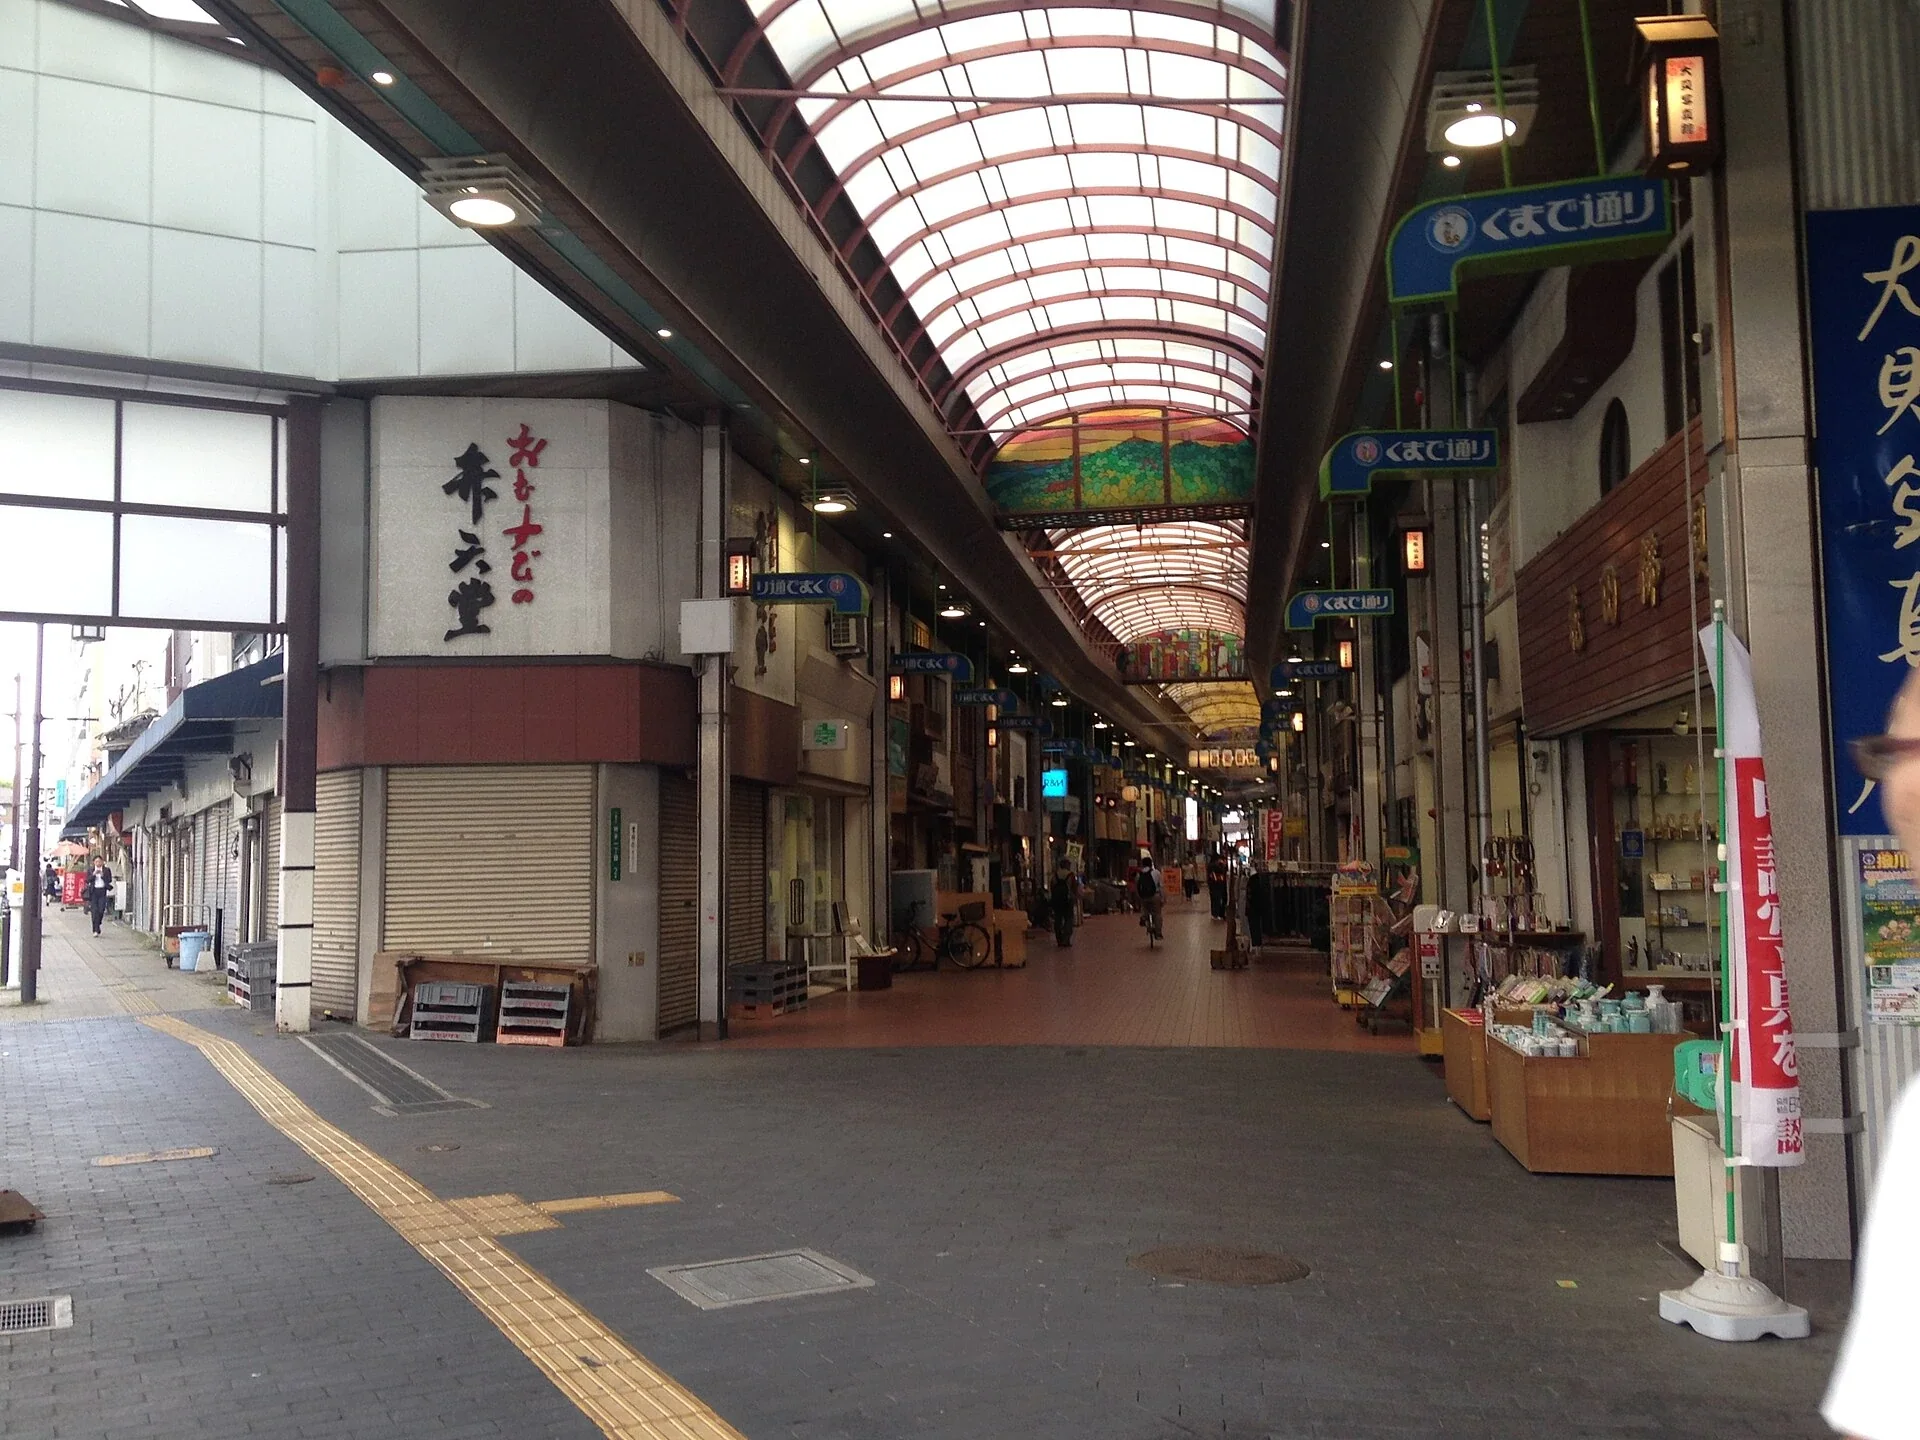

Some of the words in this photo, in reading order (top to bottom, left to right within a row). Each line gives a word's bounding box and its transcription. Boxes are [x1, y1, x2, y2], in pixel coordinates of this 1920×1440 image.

[1481, 188, 1656, 241] くまで通り
[1385, 438, 1490, 463] くまで通り
[503, 423, 548, 604] おむすびの
[1323, 595, 1389, 610] くまで通り
